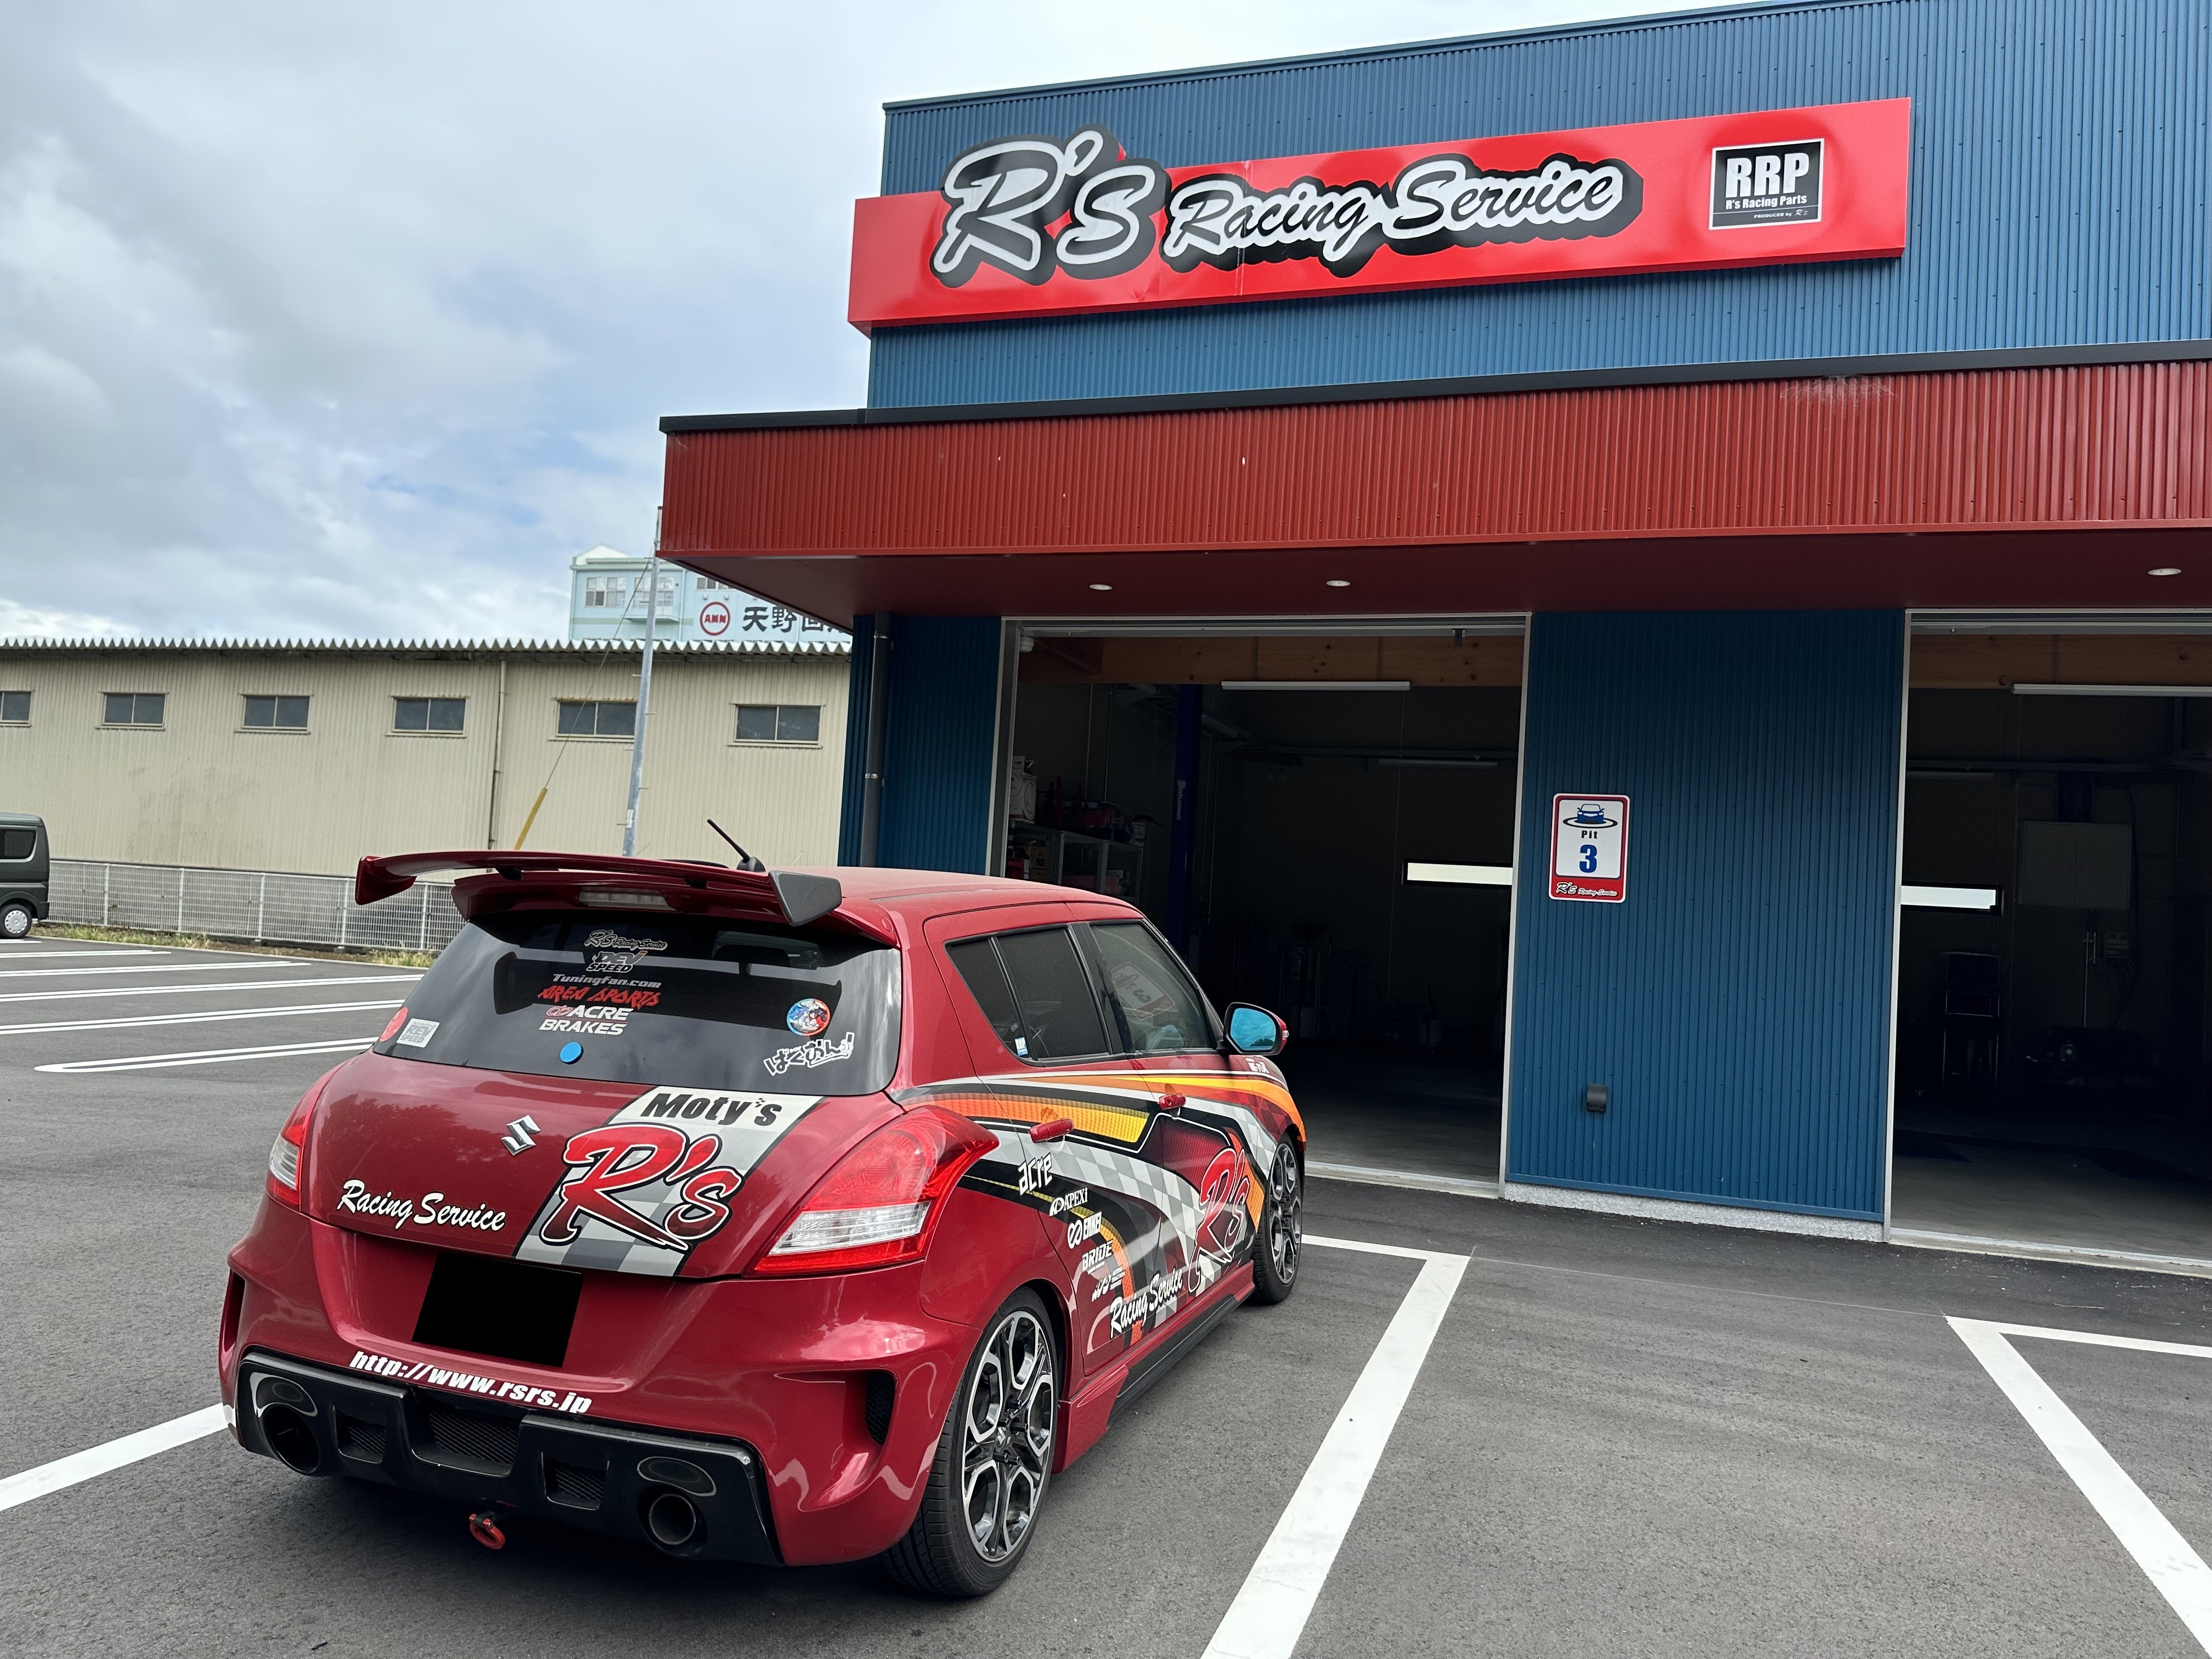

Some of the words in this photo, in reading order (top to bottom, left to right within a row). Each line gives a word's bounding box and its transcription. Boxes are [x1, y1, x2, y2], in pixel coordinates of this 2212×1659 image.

[1725, 153, 1809, 198] RRP
[932, 129, 1156, 273] R's
[1163, 179, 1377, 262] Racing
[1381, 160, 1624, 239] Service
[1725, 200, 1740, 210] R's
[1742, 198, 1778, 208] Racing
[1780, 195, 1807, 206] Parts
[1581, 830, 1598, 839] Pit
[1579, 844, 1597, 873] 3
[1556, 882, 1577, 894] R's
[1578, 888, 1598, 896] Racing
[584, 929, 618, 947] R's
[614, 937, 639, 951] Racing
[637, 939, 668, 951] Service
[586, 963, 633, 973] SPEED
[539, 1019, 627, 1035] BRAKES
[568, 1005, 634, 1020] ACRE
[400, 1034, 425, 1043] SPEED
[640, 1093, 782, 1126] Moty's
[541, 1124, 743, 1252] R's
[1018, 1152, 1052, 1195] acre
[337, 1180, 413, 1229] Racing
[414, 1193, 506, 1231] Service
[1188, 1148, 1250, 1293] R's
[1082, 1240, 1113, 1272] BRIDE
[1110, 1293, 1148, 1339] Racing
[1149, 1268, 1182, 1311] Service
[349, 1351, 592, 1414] http://www.rsrs.jp
